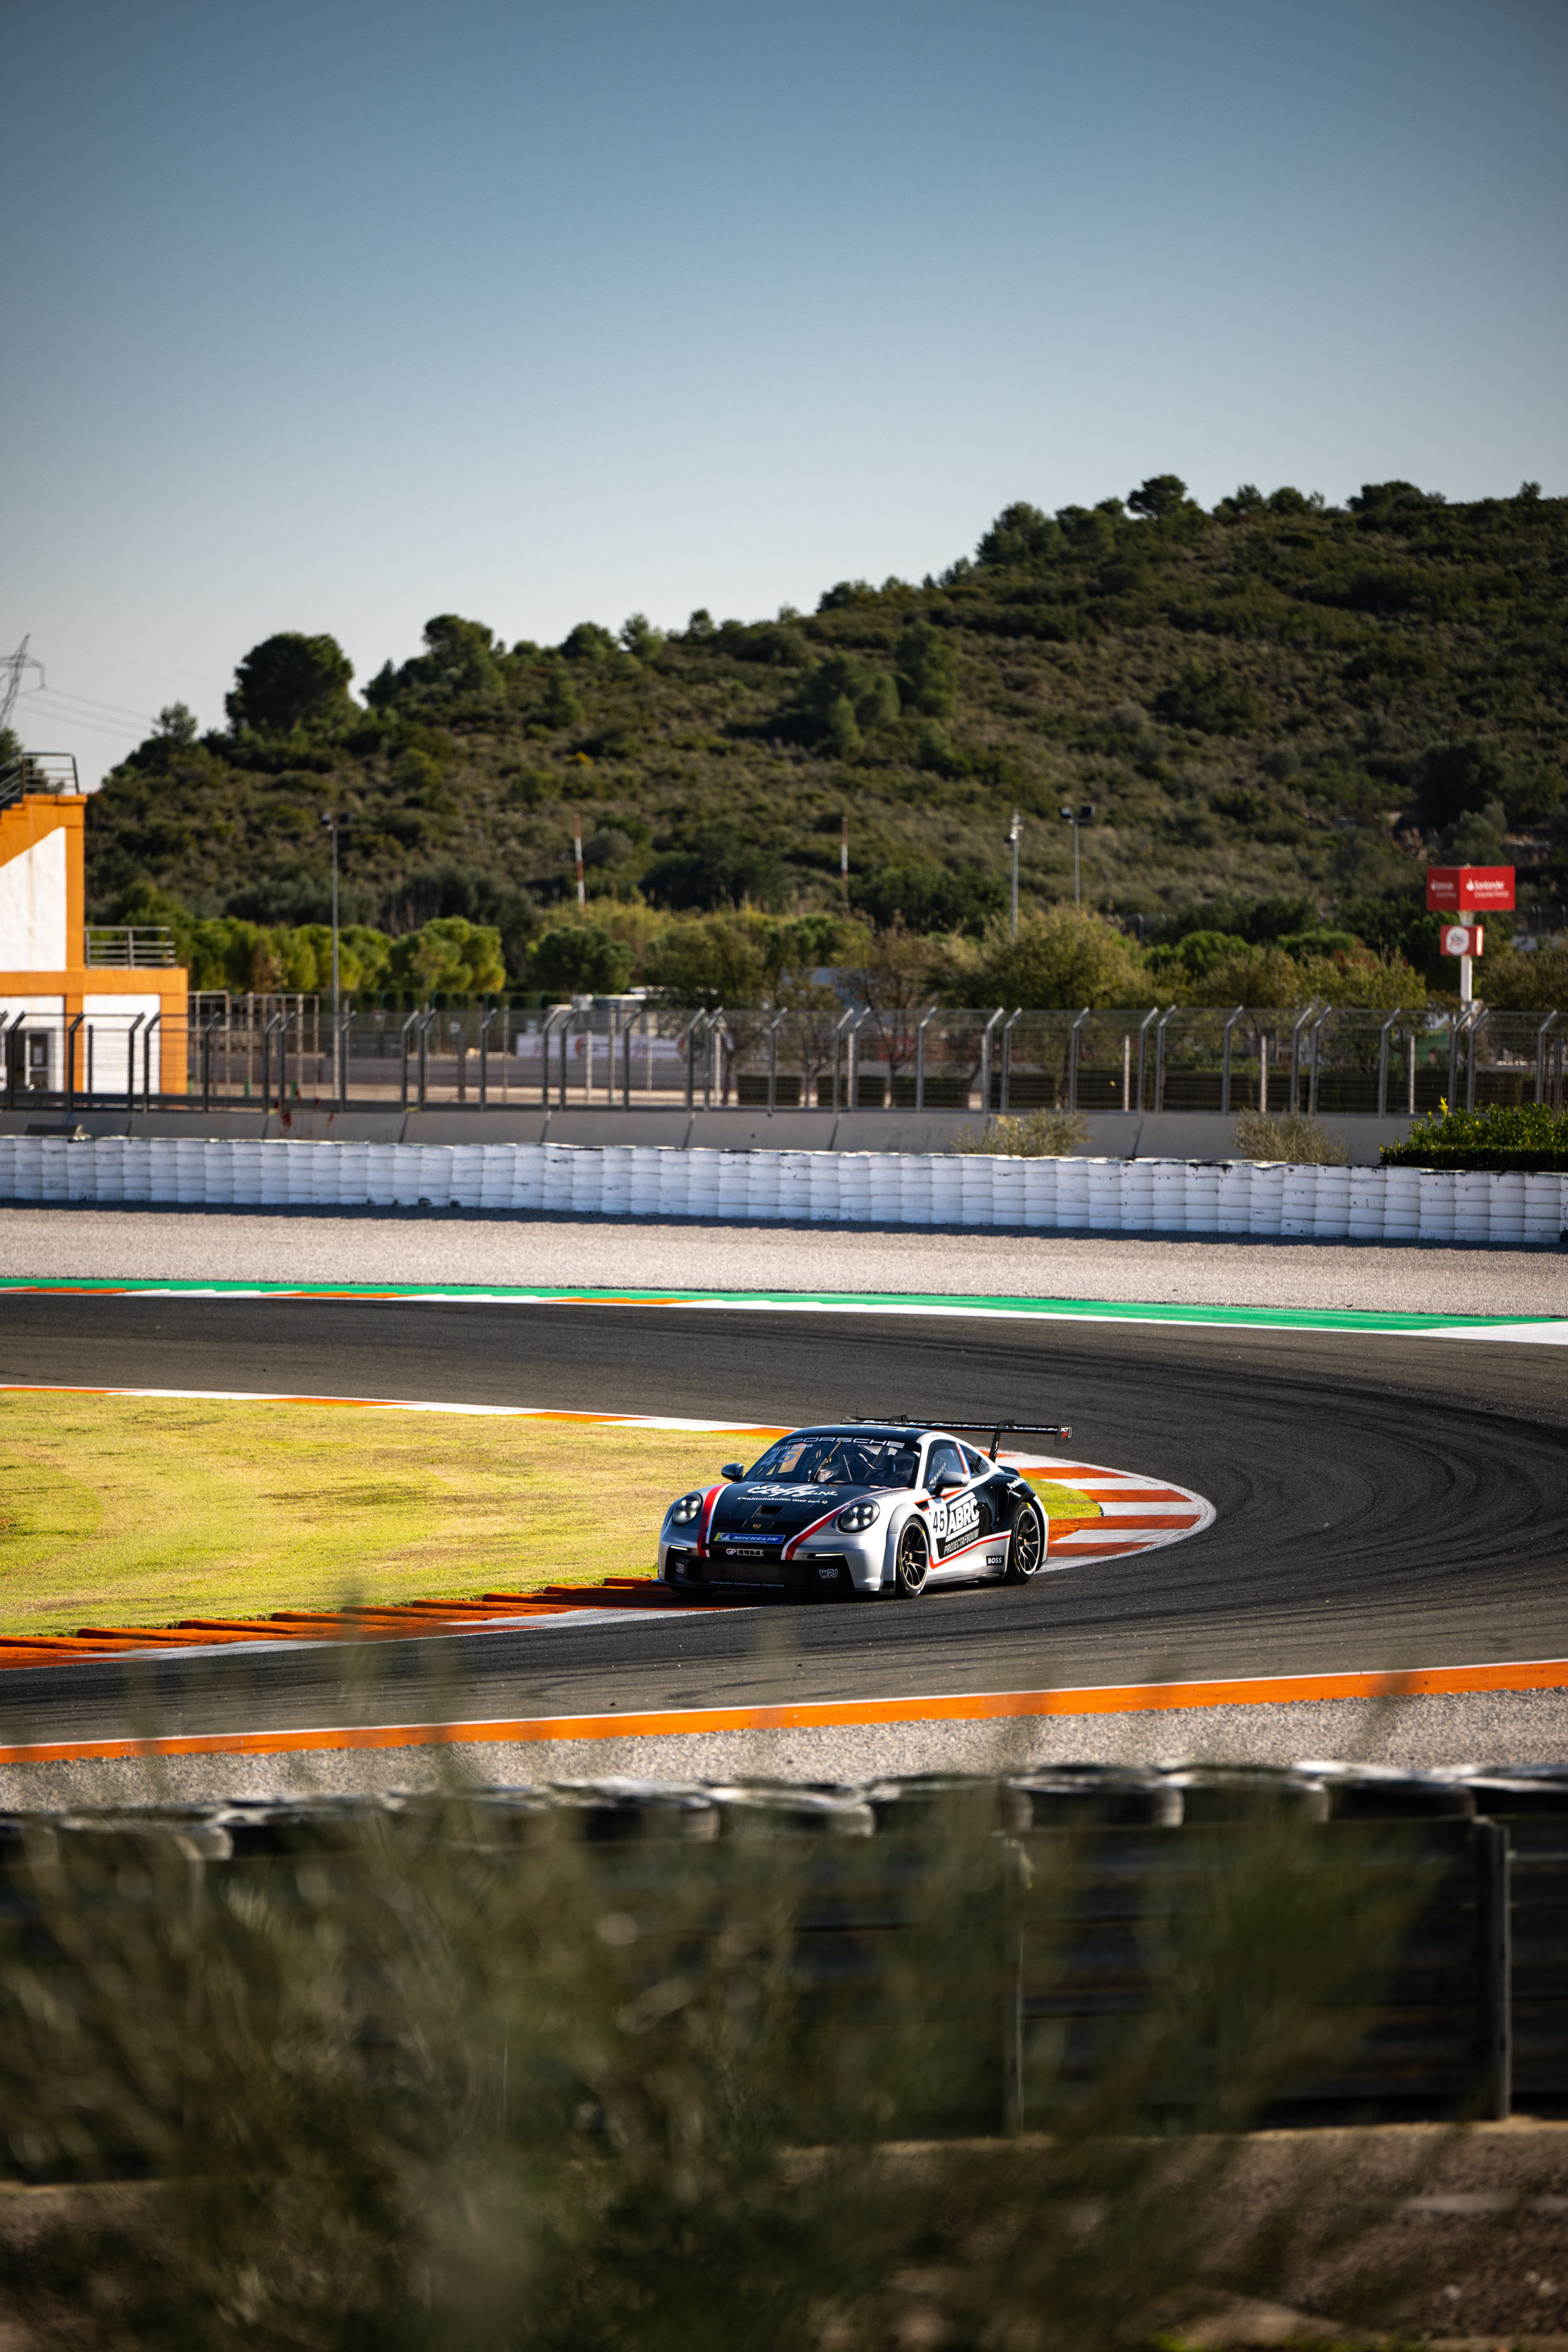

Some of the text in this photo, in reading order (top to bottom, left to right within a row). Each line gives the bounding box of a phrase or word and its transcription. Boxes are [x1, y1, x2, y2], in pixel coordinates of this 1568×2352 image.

[786, 1437, 906, 1449] PORSCHE
[760, 1449, 800, 1466] 45
[933, 1510, 945, 1533] 45
[944, 1527, 980, 1556] PROJECTAFBOUW
